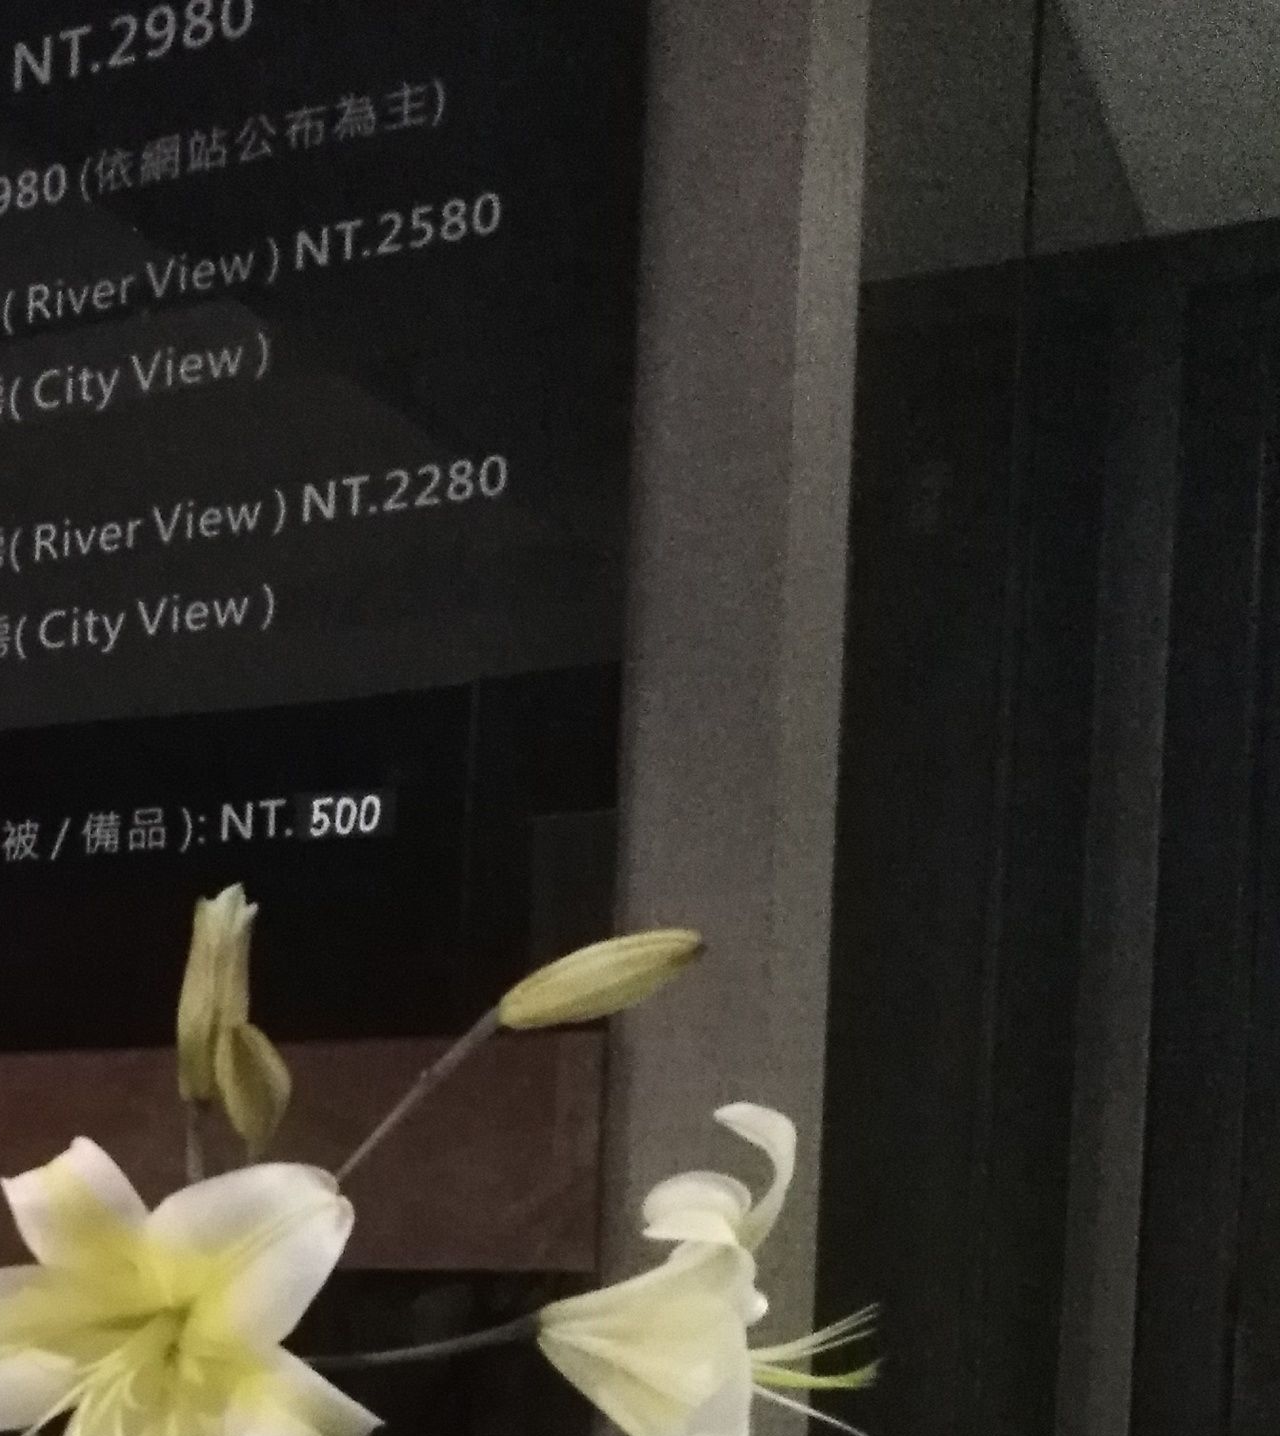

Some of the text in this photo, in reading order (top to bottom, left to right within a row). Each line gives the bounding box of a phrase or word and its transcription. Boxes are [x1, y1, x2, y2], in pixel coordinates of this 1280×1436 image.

[13, 0, 254, 93] NT.2980
[295, 191, 502, 272] NT.2580
[301, 454, 509, 525] NT.2280
[308, 794, 383, 838] 500
